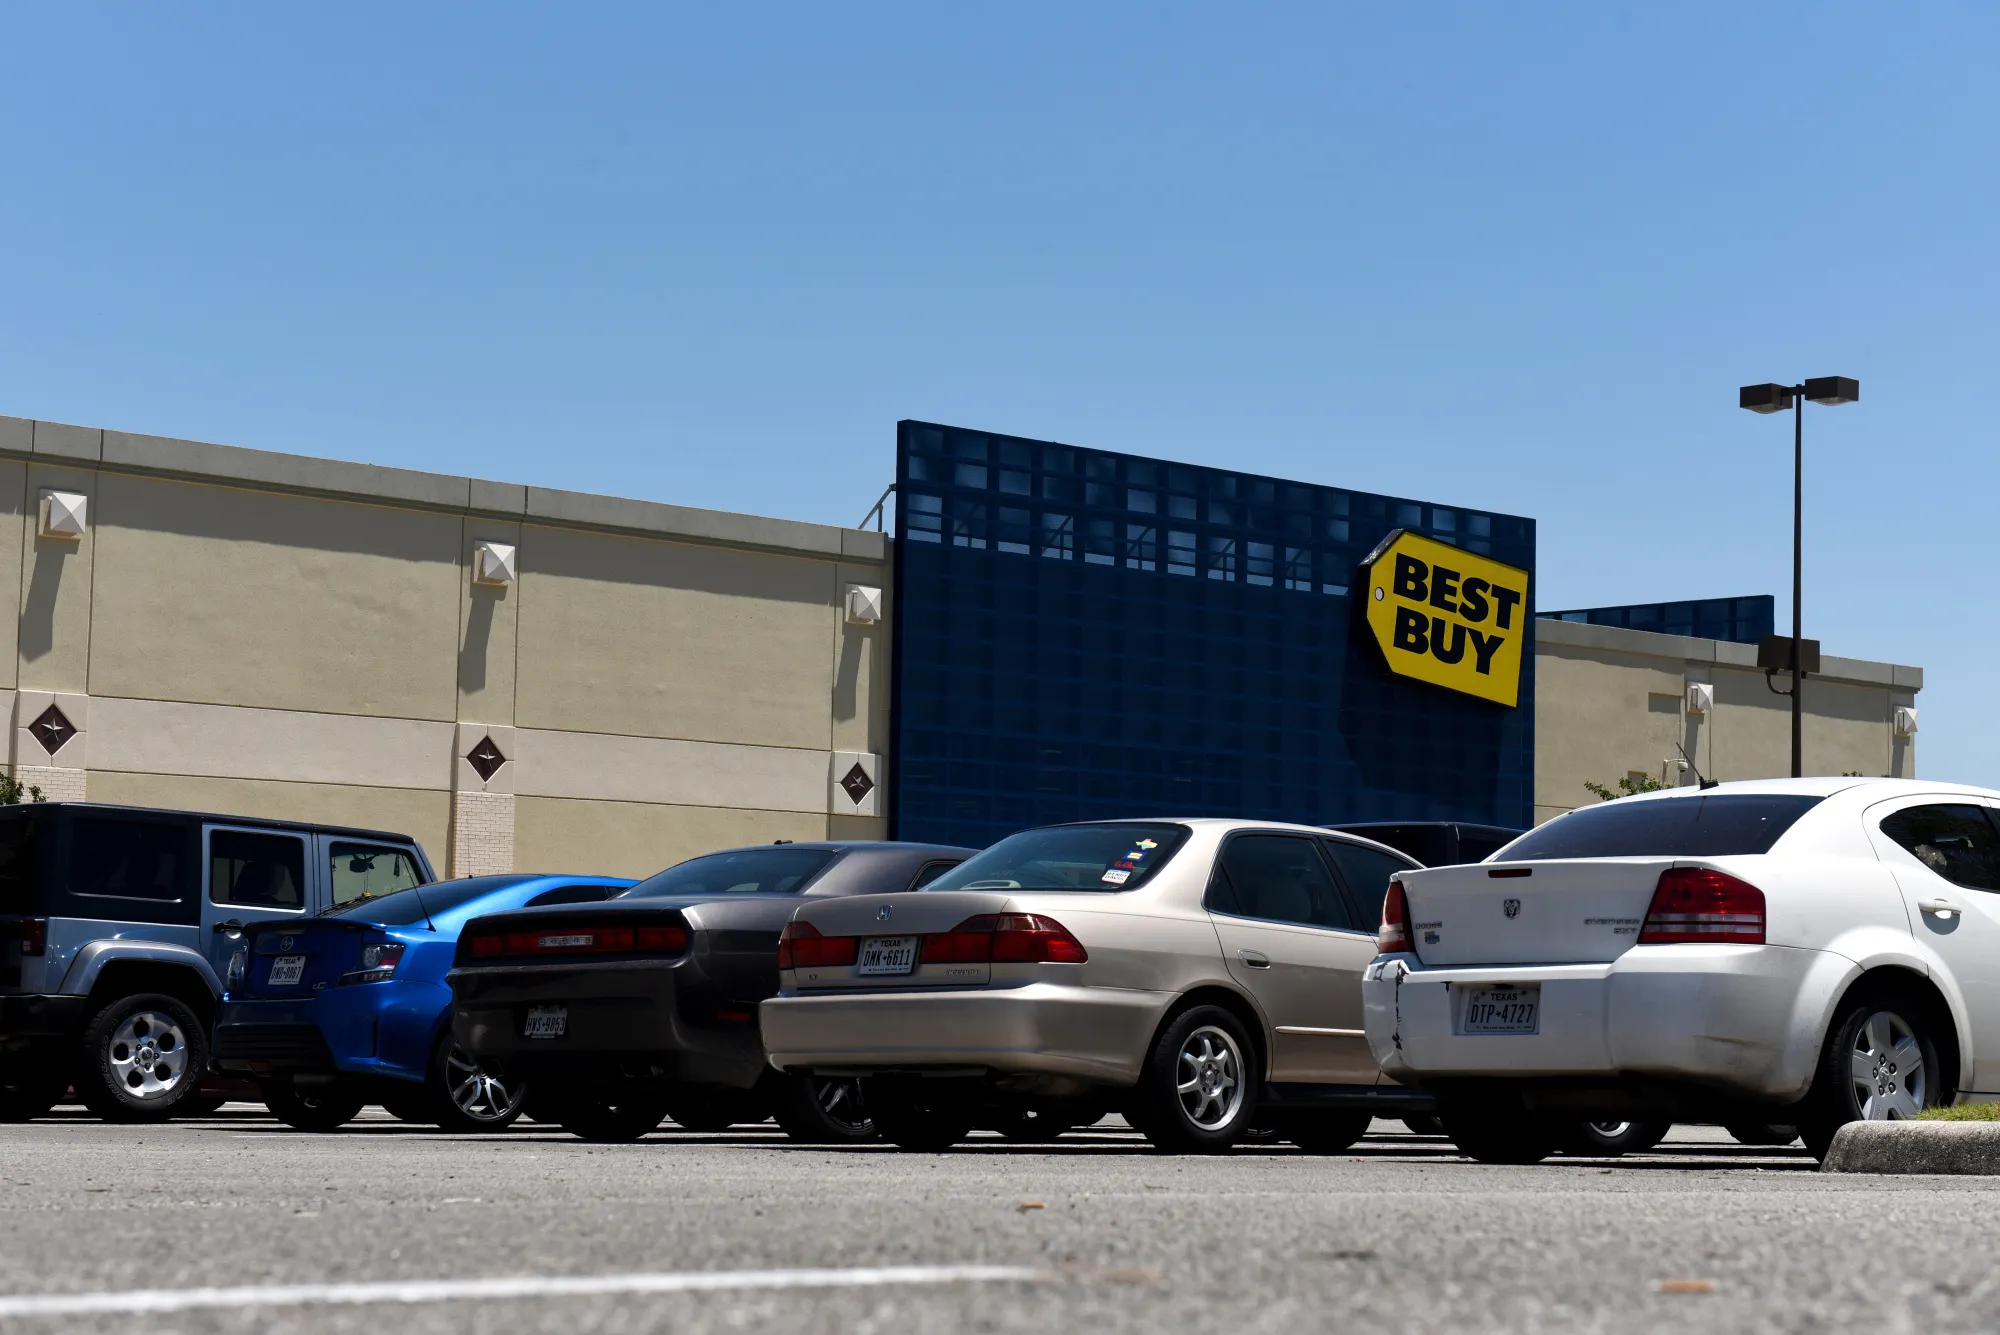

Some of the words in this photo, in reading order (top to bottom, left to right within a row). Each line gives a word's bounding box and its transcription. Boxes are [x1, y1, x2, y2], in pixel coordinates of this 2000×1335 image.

[1393, 552, 1521, 630] BEST
[1393, 605, 1505, 675] BUY
[881, 939, 901, 947] TEXAS
[1491, 992, 1518, 1001] TEXAS
